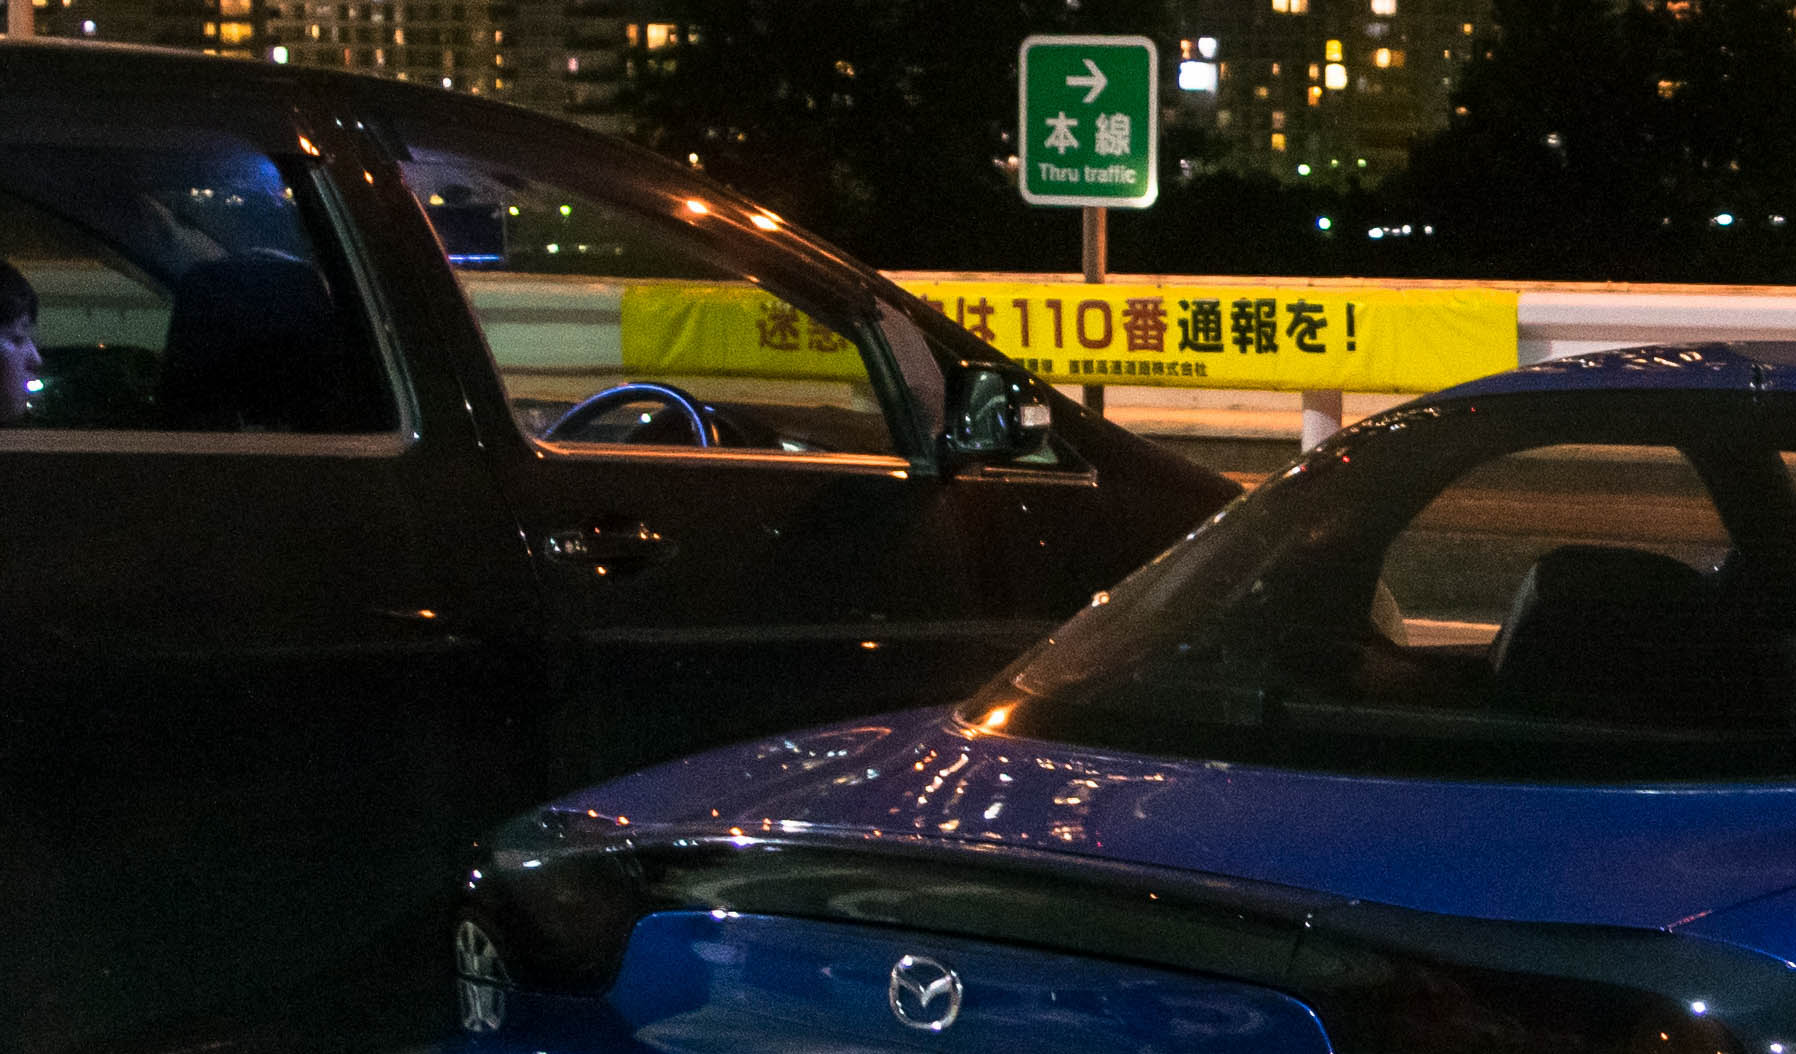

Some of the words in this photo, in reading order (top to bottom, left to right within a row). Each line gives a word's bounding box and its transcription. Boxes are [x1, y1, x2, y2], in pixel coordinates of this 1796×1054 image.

[1043, 112, 1132, 157] 本線
[1038, 163, 1080, 184] Thru
[1084, 165, 1138, 184] traffic
